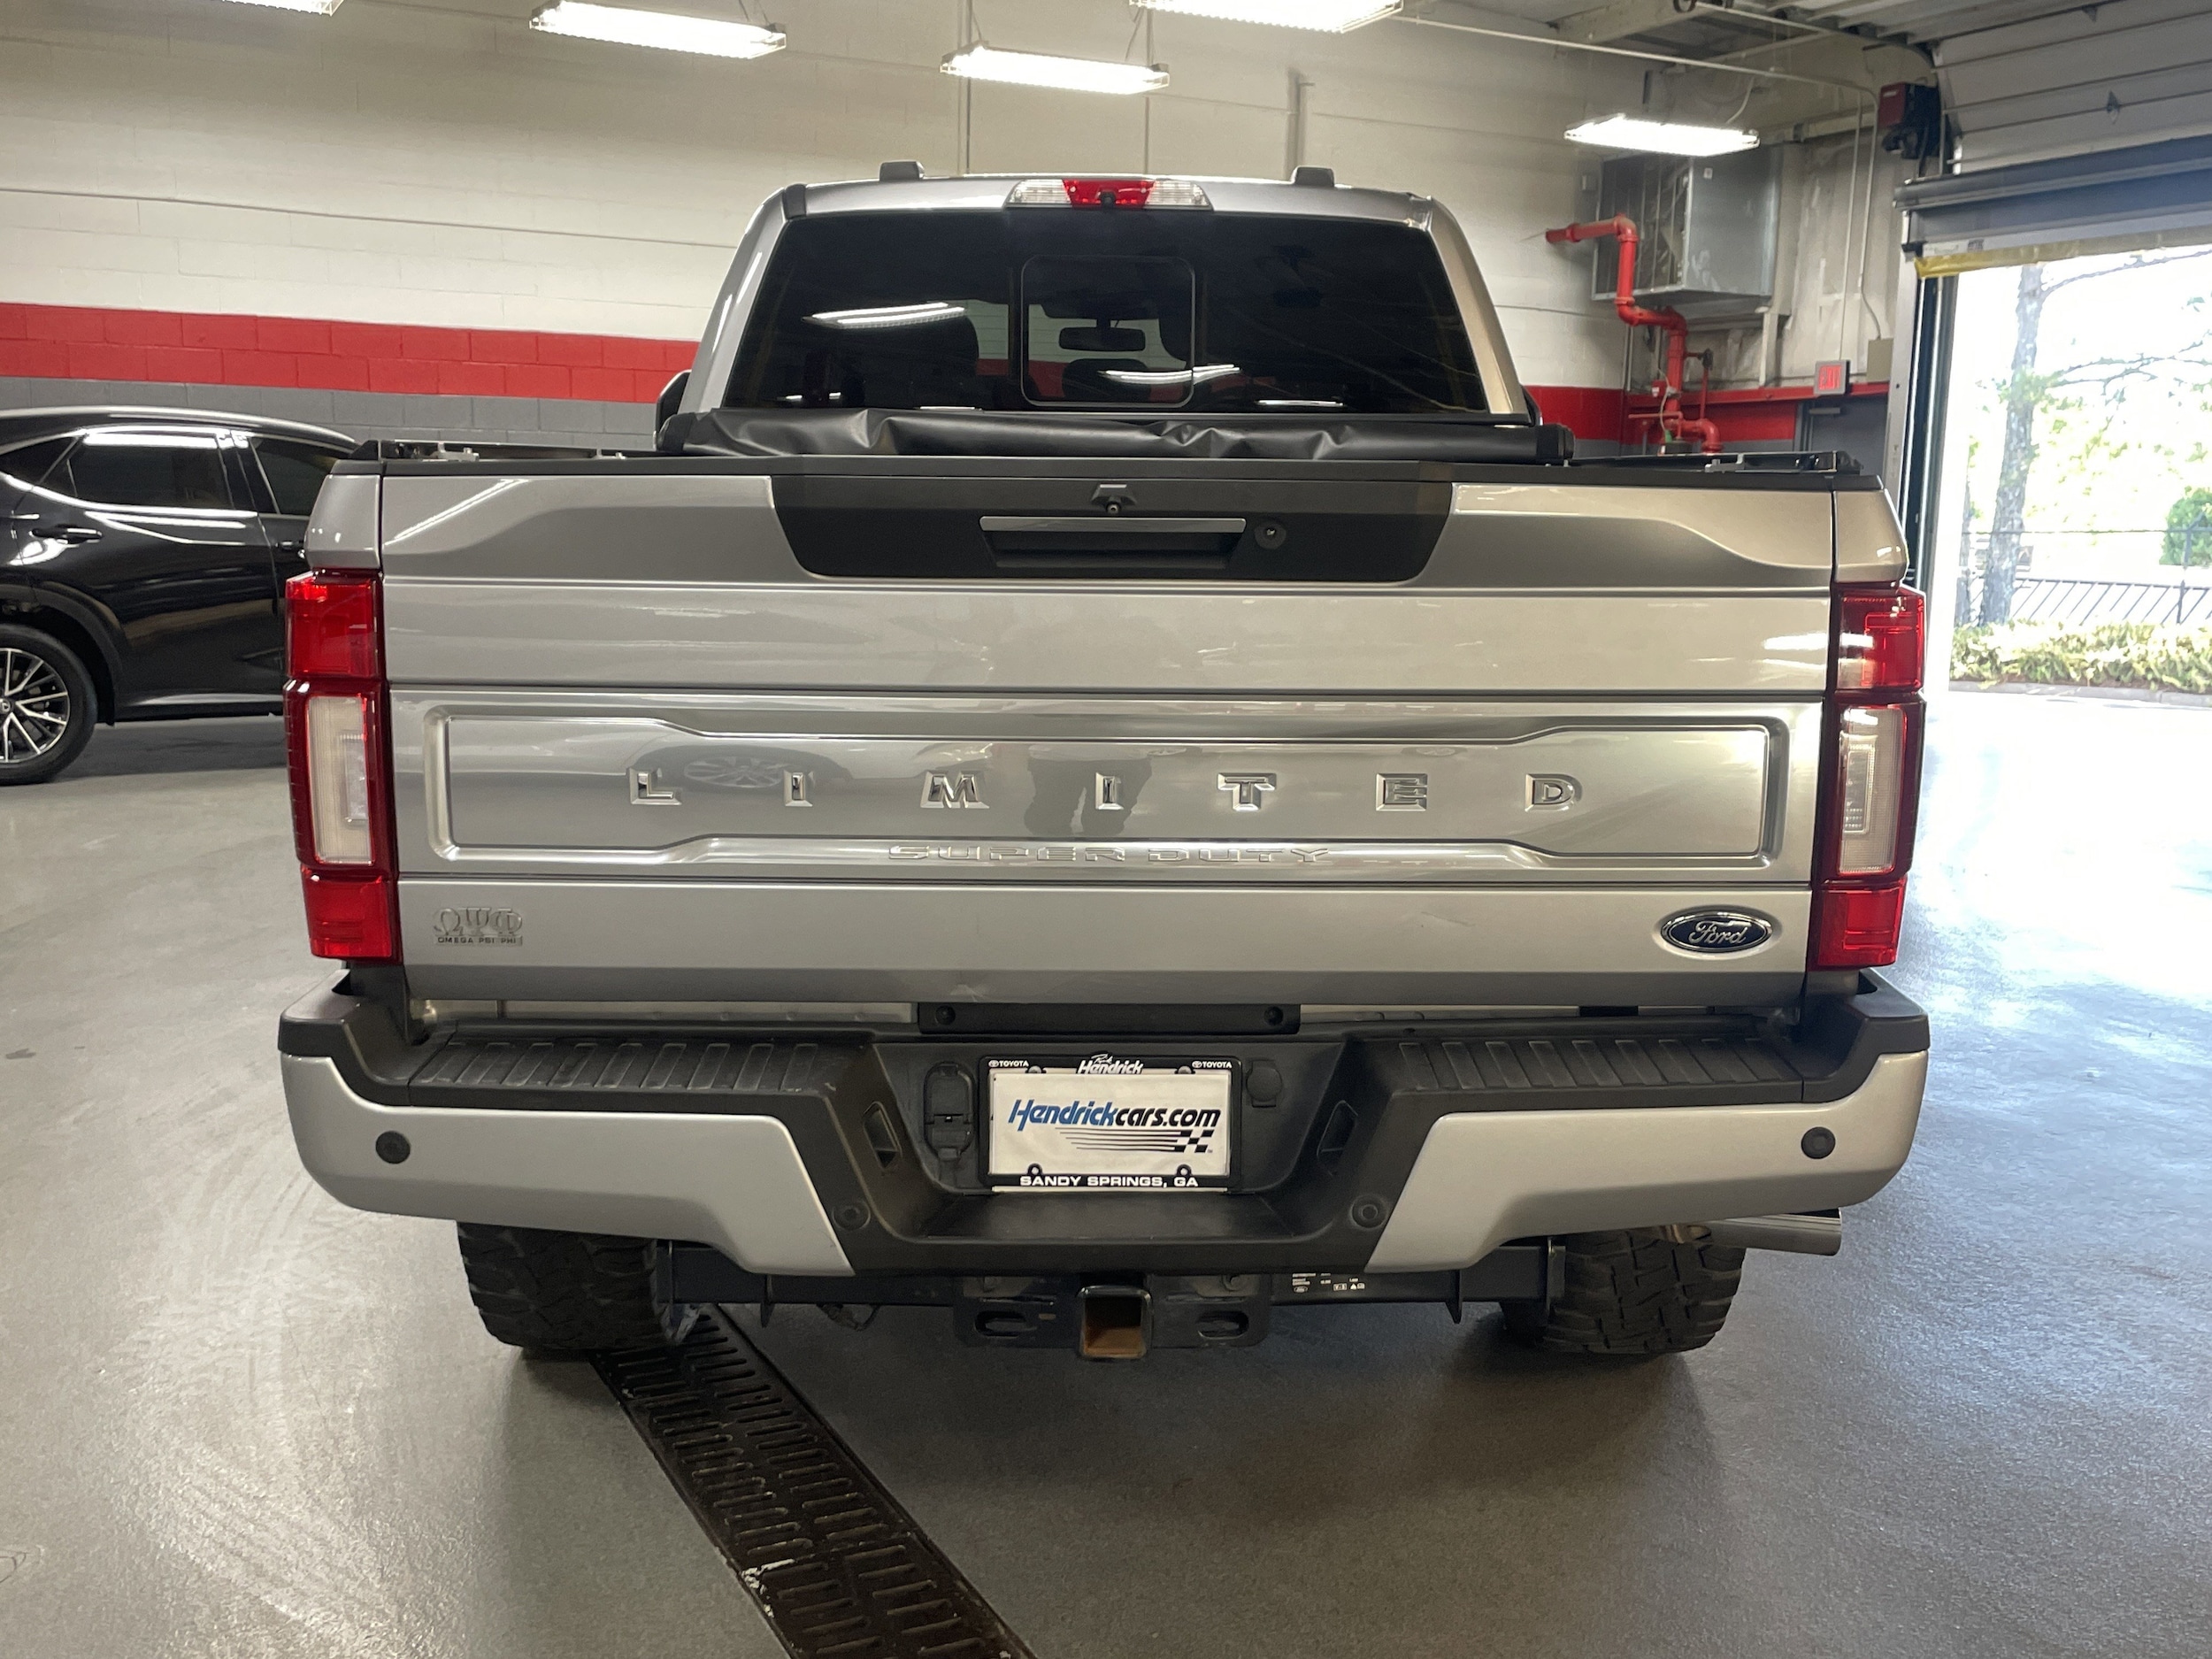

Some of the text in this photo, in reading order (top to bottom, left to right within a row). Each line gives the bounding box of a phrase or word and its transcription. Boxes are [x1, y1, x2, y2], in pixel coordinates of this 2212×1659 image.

[629, 767, 1583, 814] LIMITED
[887, 844, 1330, 864] SUPER DUTY
[1688, 920, 1752, 944] Ford
[1077, 1059, 1144, 1074] Hendrick
[1008, 1099, 1221, 1132] Hendrickcars.com
[1019, 1175, 1198, 1188] SANDY SPRINGS, GA
